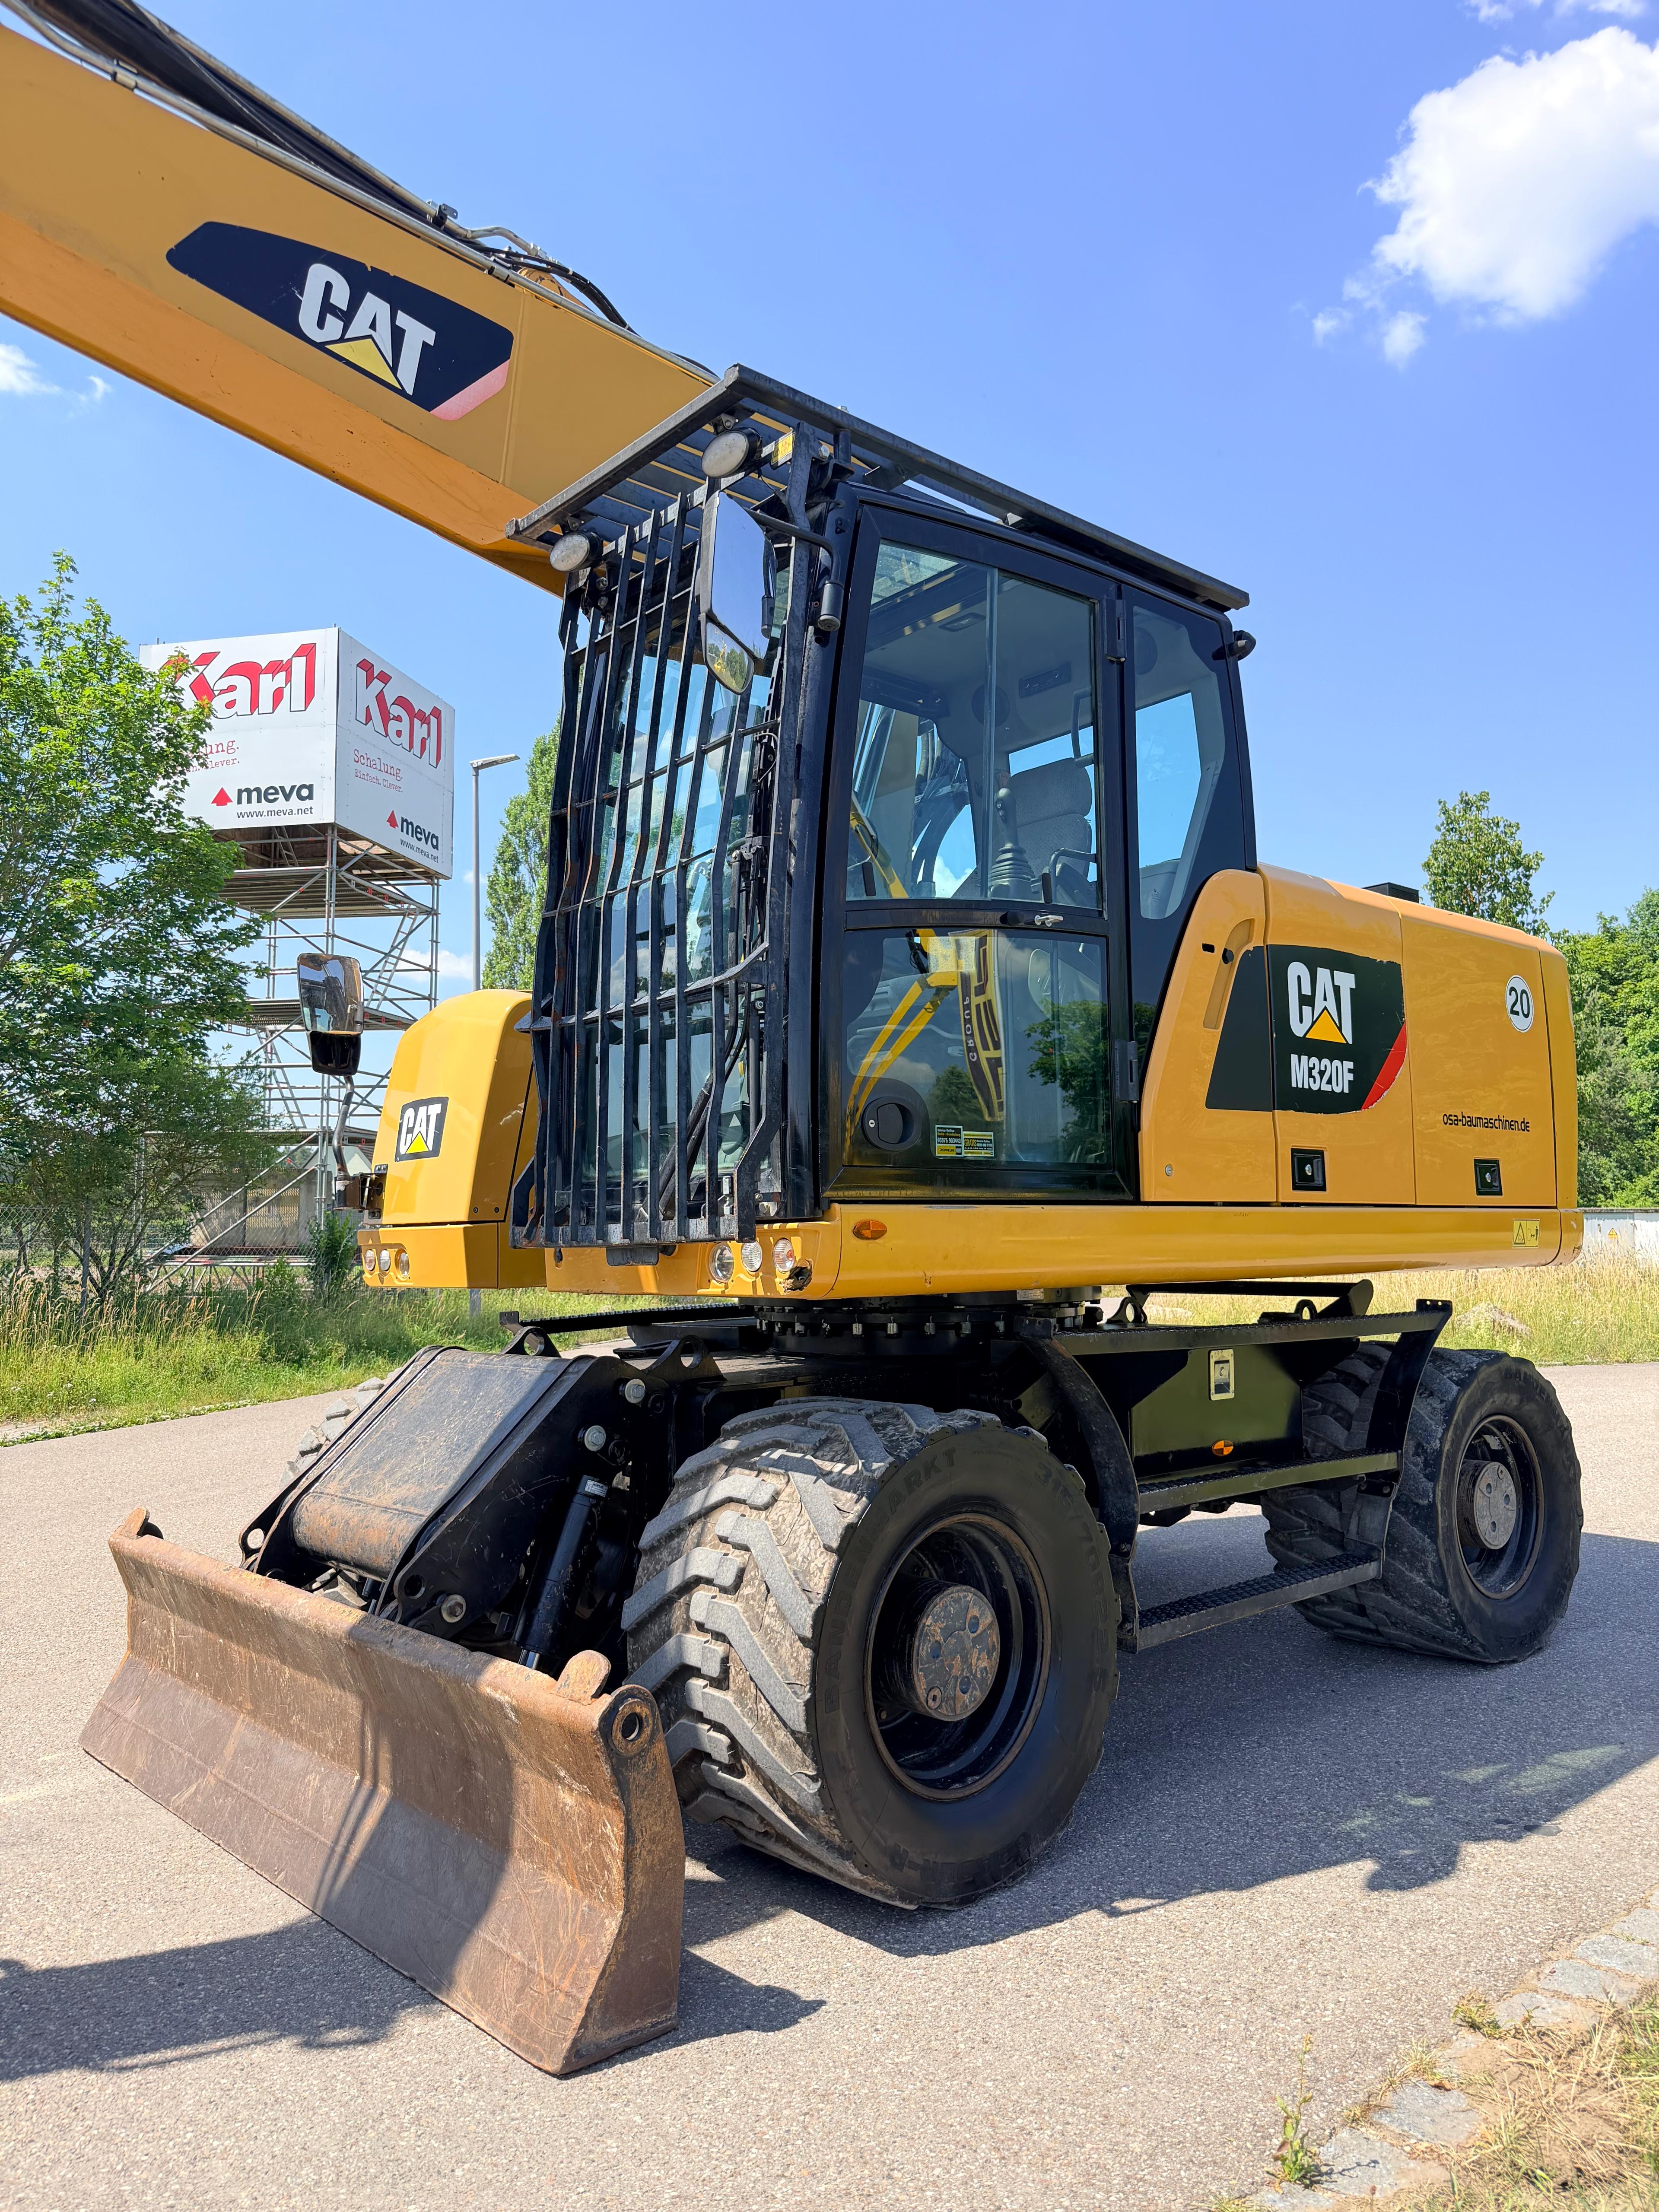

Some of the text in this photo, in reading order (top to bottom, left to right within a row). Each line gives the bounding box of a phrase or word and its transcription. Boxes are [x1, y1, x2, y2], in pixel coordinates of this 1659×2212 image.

[299, 263, 436, 396] CAT
[356, 658, 442, 769] Karl
[354, 749, 403, 782] Schalung.
[354, 769, 403, 793] Einfach. Clever.
[237, 784, 314, 805] meva
[236, 806, 314, 819] www.meva.net
[400, 816, 439, 851] meva
[400, 838, 439, 864] www.meva.net
[1287, 961, 1356, 1044] CAT
[1508, 986, 1531, 1019] 20
[1290, 1054, 1354, 1093] M320F
[399, 1103, 442, 1154] CAT
[1443, 1111, 1530, 1132] osa-baumaschinen.de
[824, 1446, 957, 1715] BANDENMARKT
